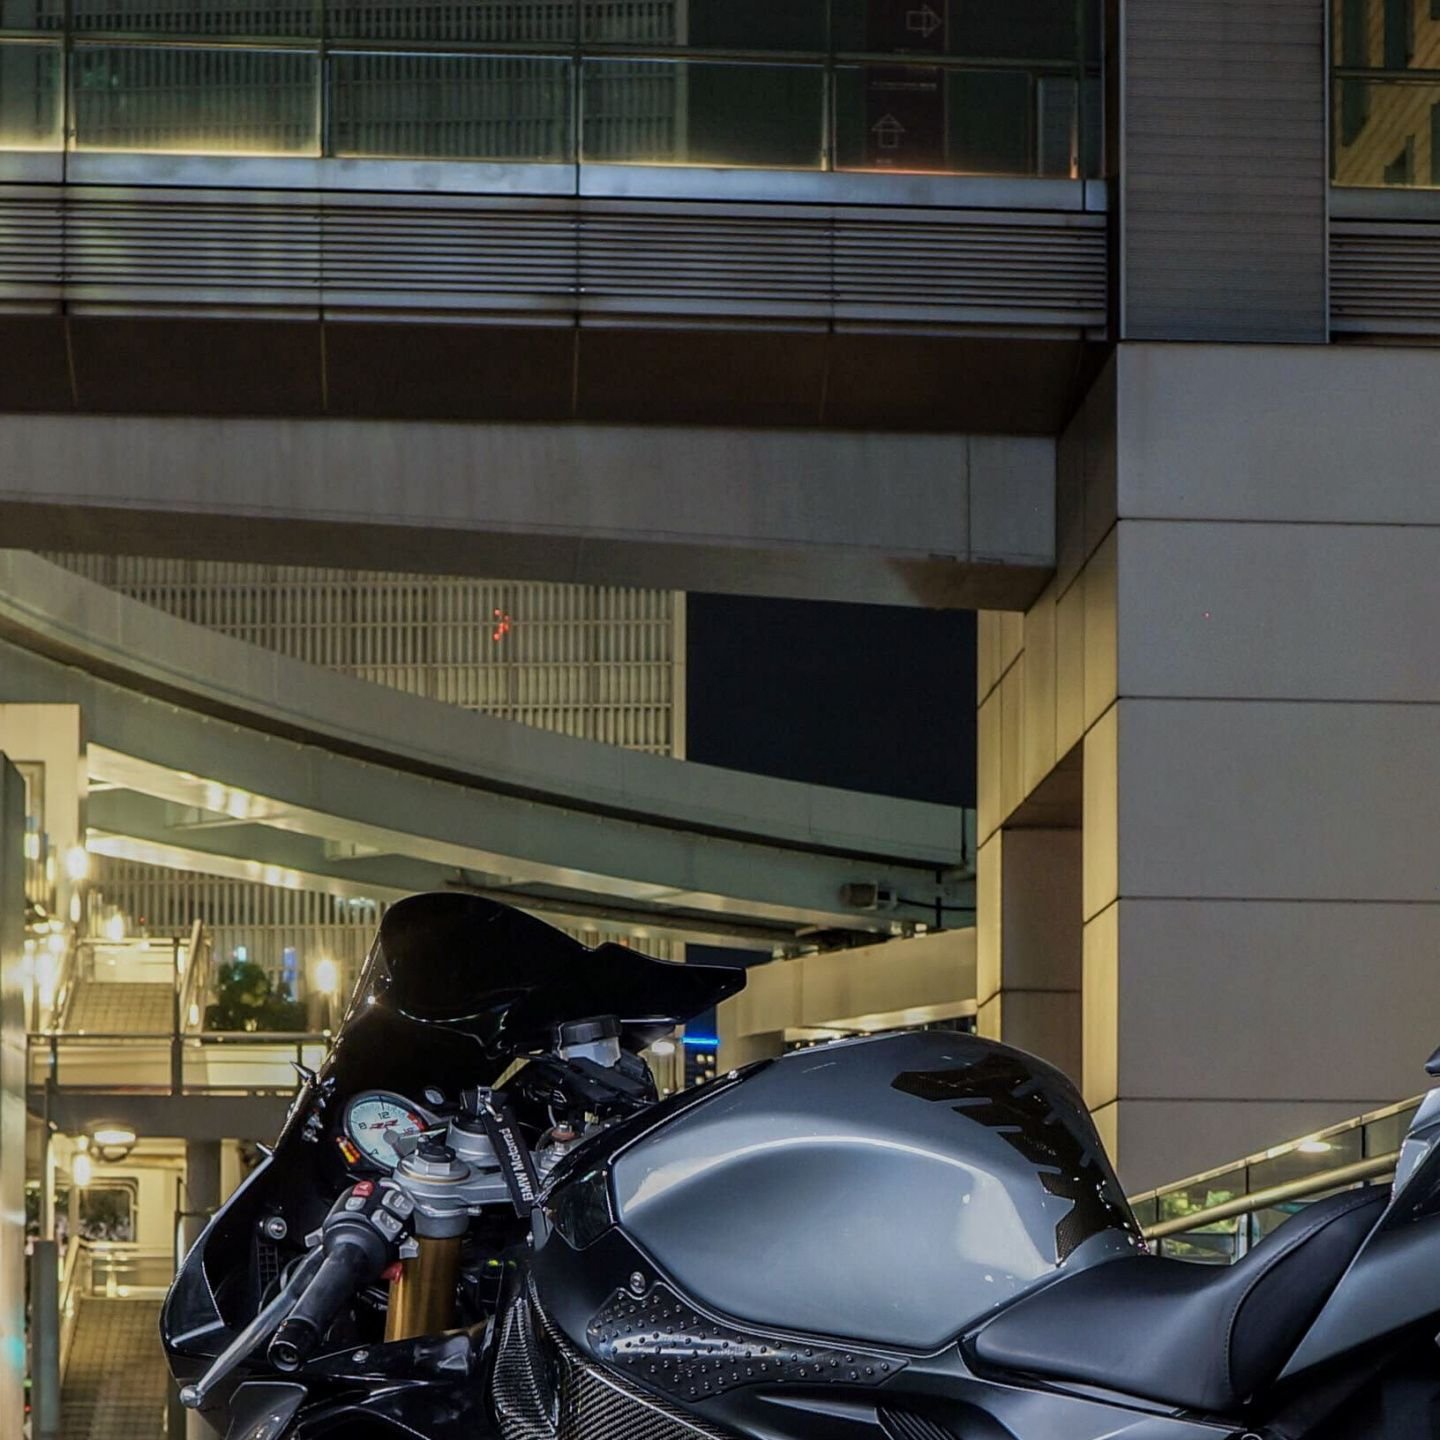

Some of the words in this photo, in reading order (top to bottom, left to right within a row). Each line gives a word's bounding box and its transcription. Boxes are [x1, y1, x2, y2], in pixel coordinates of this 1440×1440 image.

[378, 1111, 391, 1120] 12
[498, 1127, 525, 1172] Motorrad
[514, 1172, 535, 1201] BMW
